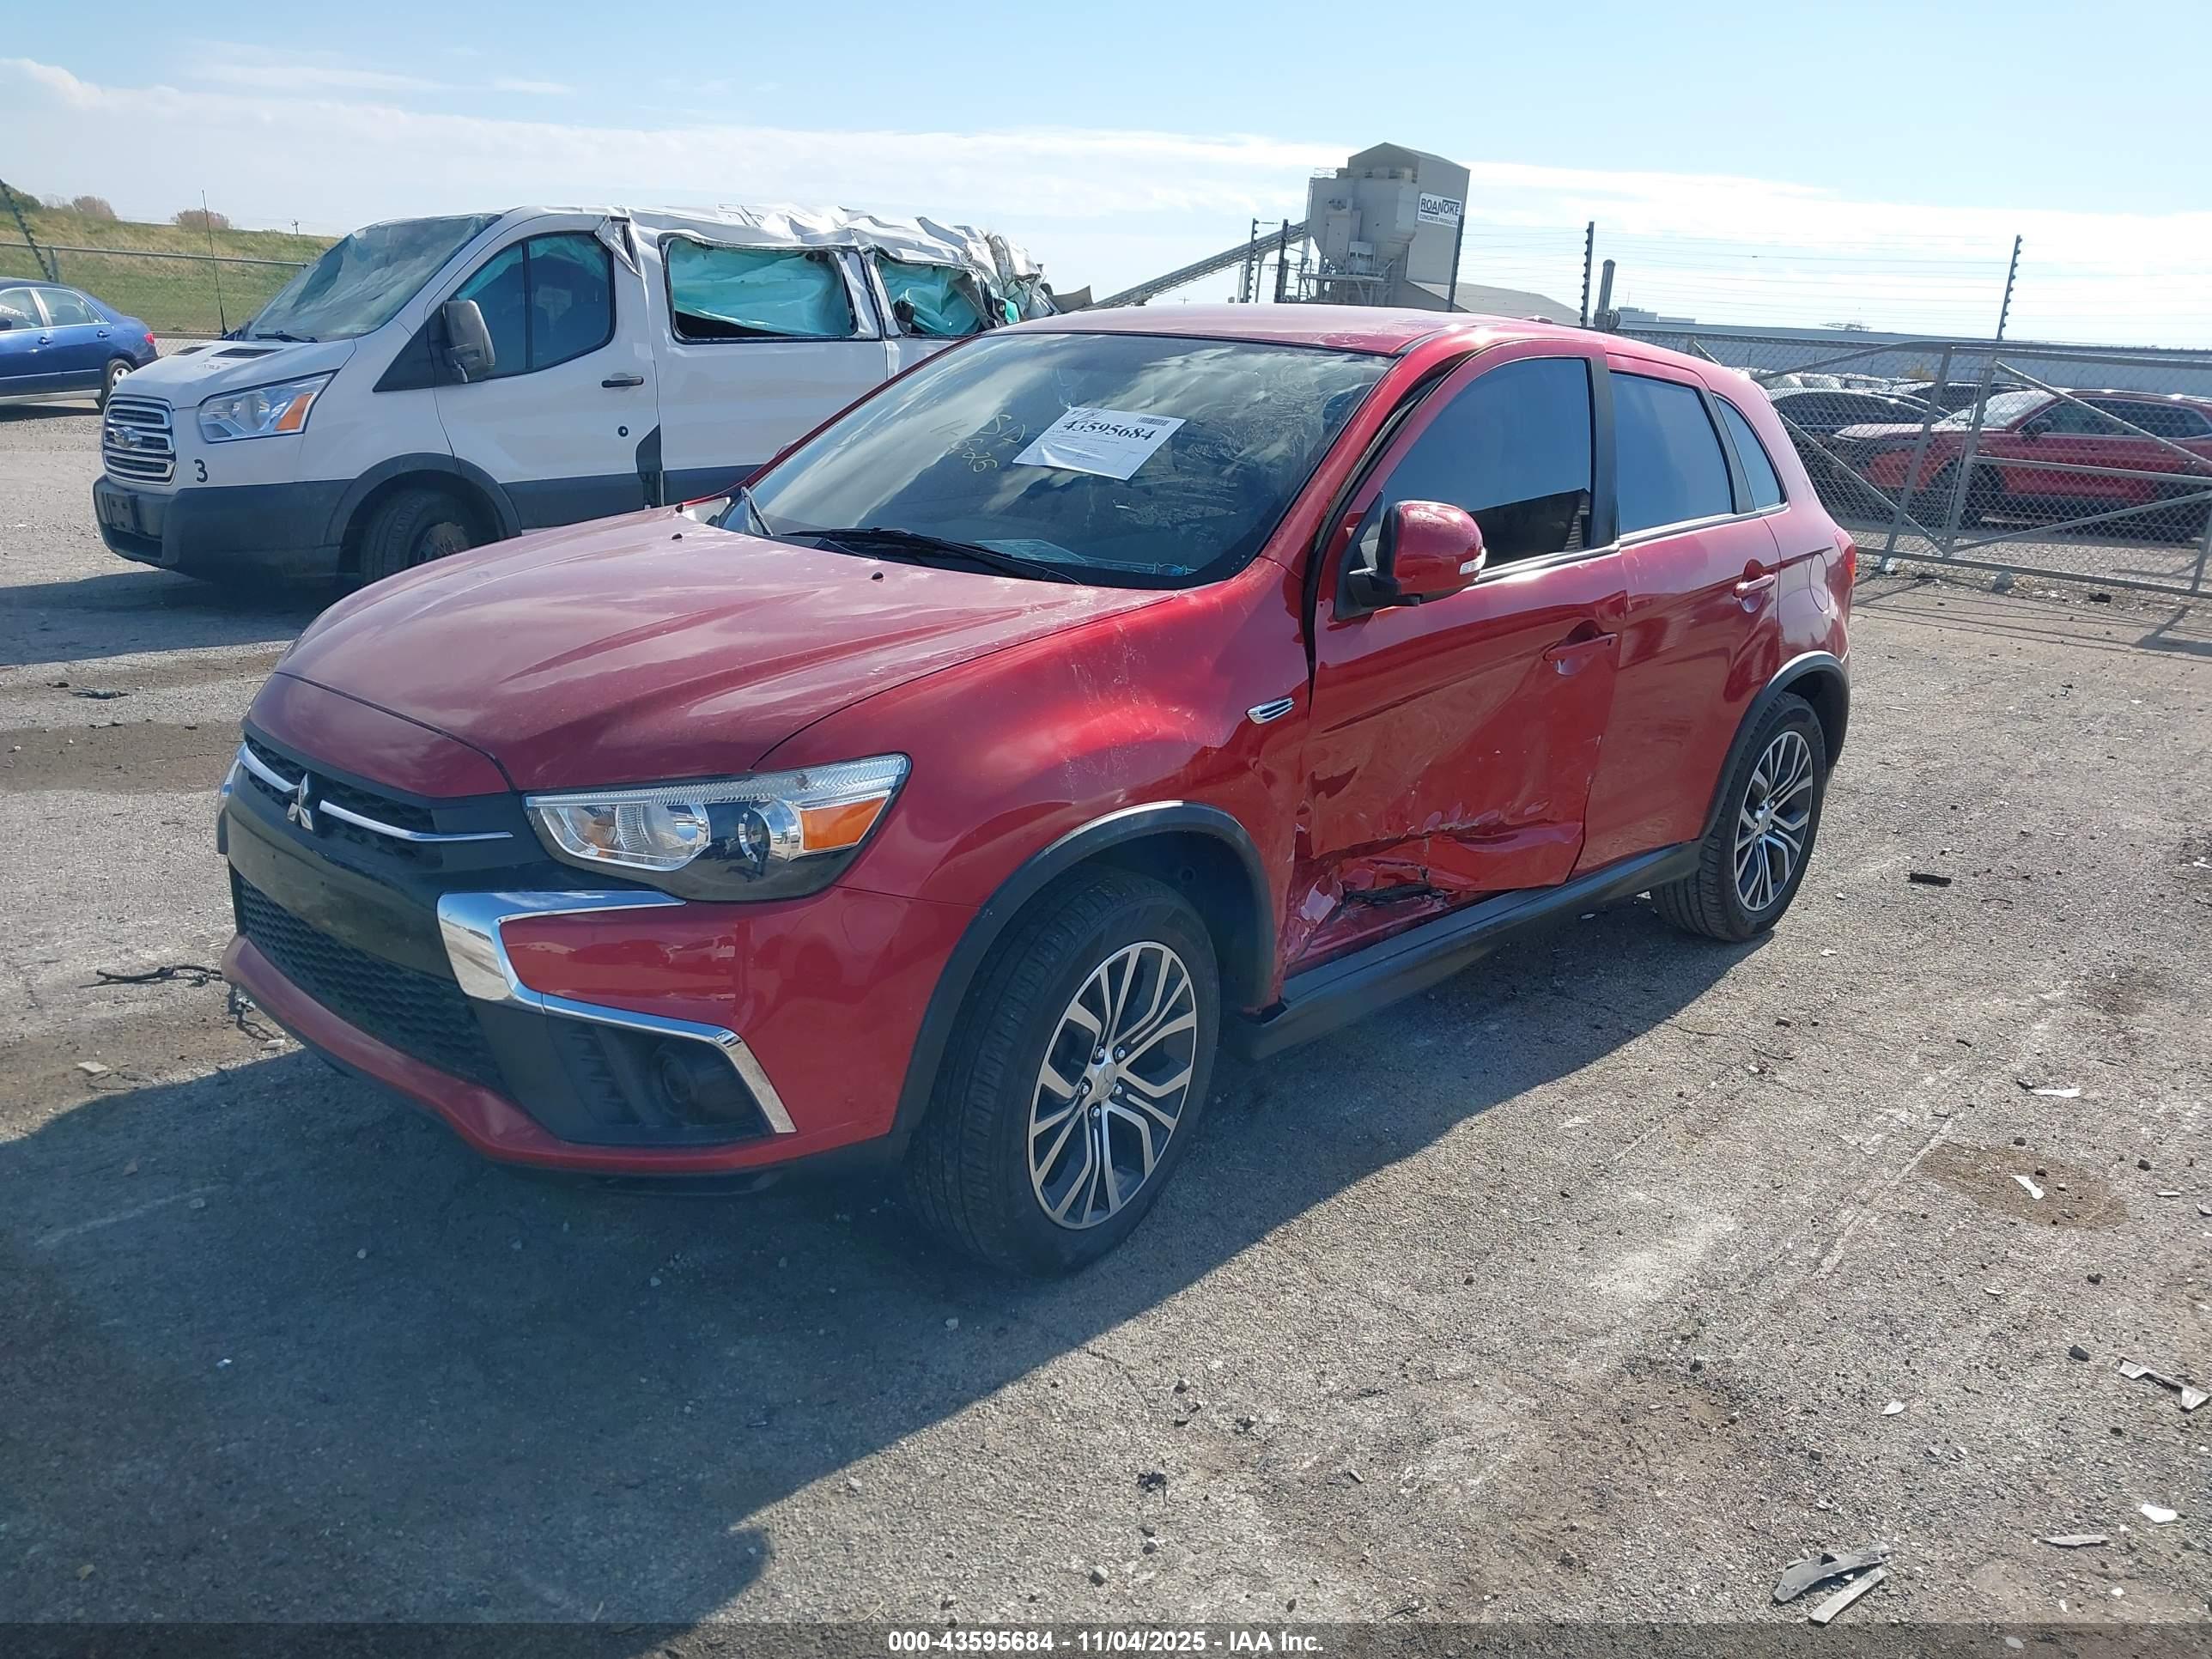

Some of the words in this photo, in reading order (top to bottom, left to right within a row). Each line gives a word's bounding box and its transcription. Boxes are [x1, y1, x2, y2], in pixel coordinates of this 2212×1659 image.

[1420, 198, 1460, 216] ROANOKE
[1063, 420, 1157, 441] 43595684
[194, 459, 208, 483] 3
